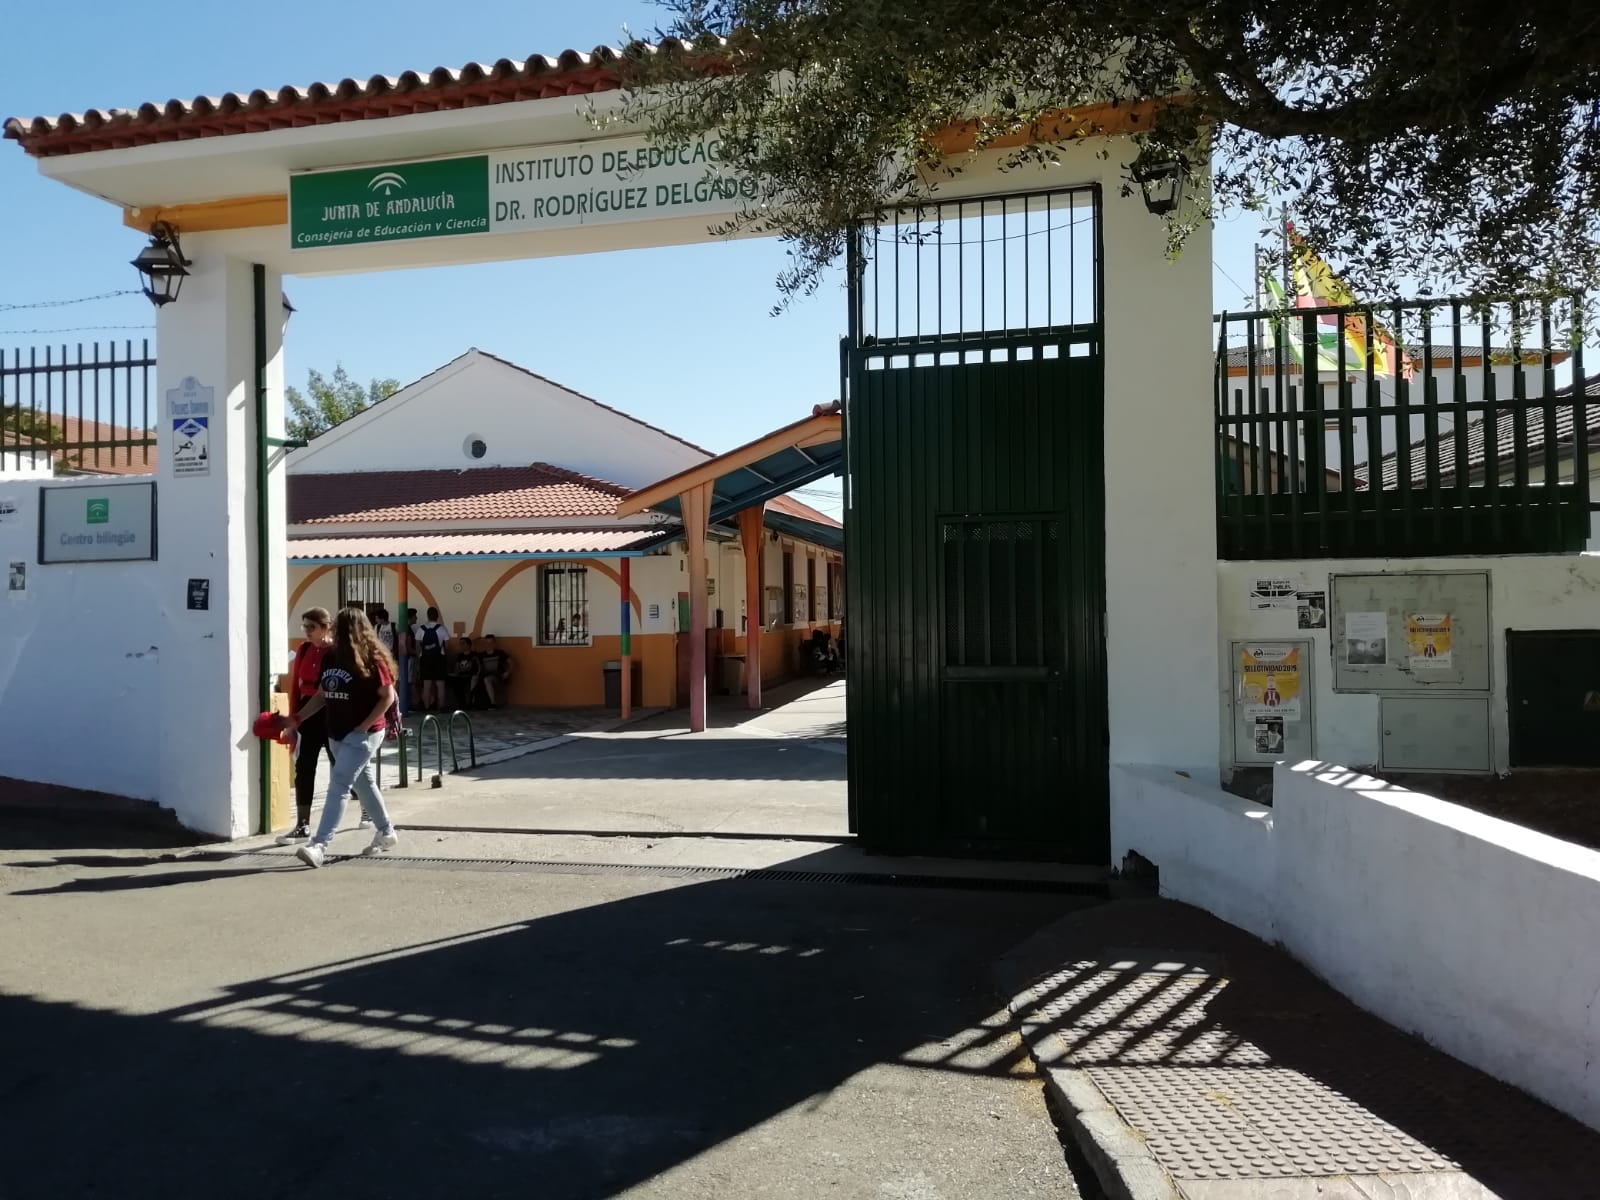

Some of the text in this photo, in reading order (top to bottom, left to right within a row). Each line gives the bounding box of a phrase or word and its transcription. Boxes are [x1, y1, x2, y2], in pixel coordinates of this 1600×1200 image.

[495, 154, 594, 184] INSTITUTO
[602, 150, 629, 173] DE
[321, 191, 455, 221] JUNTA DE ANDALUCÍA
[495, 176, 757, 222] DR. RODRÍGUEZ DELGADO
[357, 227, 371, 238] de
[446, 217, 487, 230] Ciencia
[60, 530, 136, 546] Centro bilingüe
